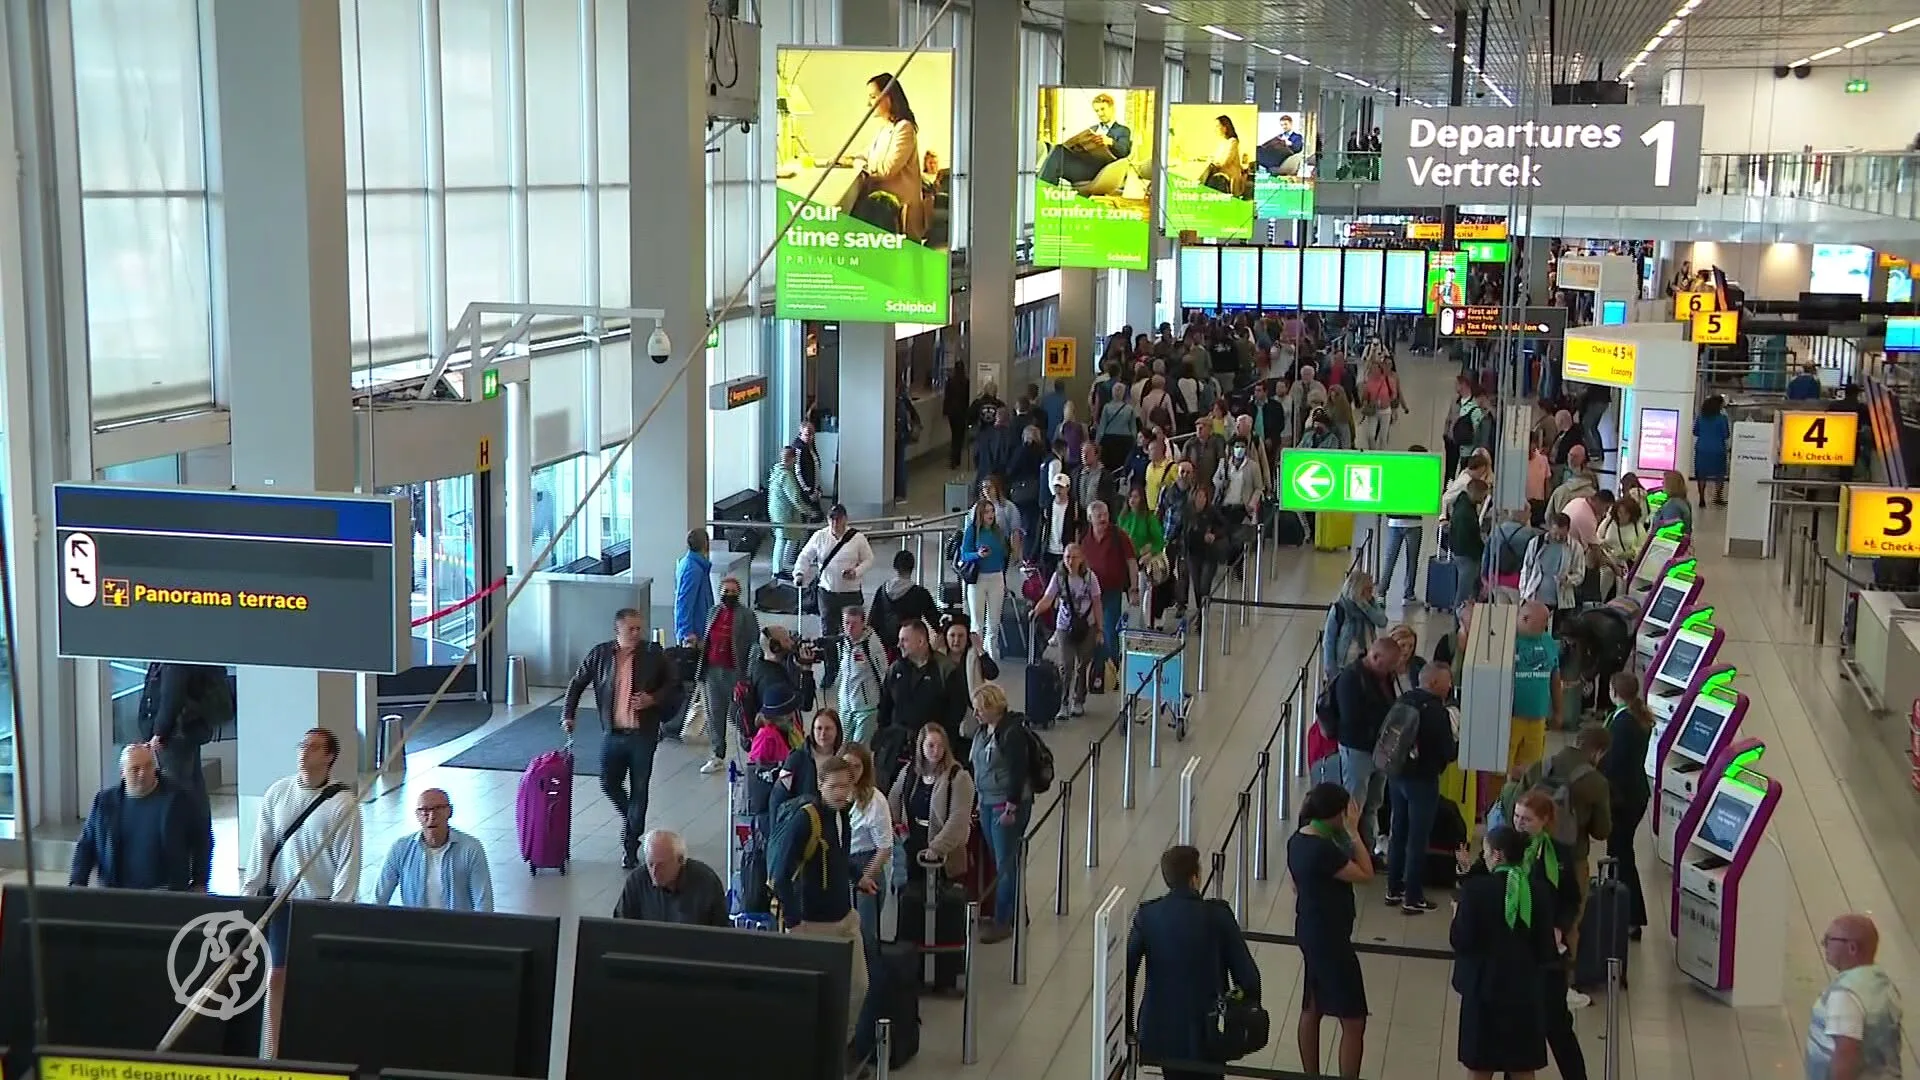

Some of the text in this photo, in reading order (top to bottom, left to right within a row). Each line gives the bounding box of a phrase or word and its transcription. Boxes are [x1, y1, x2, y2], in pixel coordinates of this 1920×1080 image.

[1409, 119, 1622, 155] Departures
[1640, 120, 1676, 187] 1
[1407, 155, 1543, 187] Vertrek
[1043, 186, 1079, 201] Your
[786, 200, 842, 222] Your
[1041, 205, 1145, 221] comfort zone
[786, 225, 907, 249] time saver
[786, 256, 860, 266] PRIVIUM
[885, 299, 937, 314] Schiphol
[1690, 294, 1702, 311] 6
[1708, 315, 1721, 334] 5
[1803, 417, 1829, 449] 4
[480, 439, 489, 465] H
[1805, 452, 1844, 461] Check-in
[1883, 496, 1913, 537] 3
[134, 585, 309, 610] Panorama terrace
[70, 1063, 117, 1080] Flight
